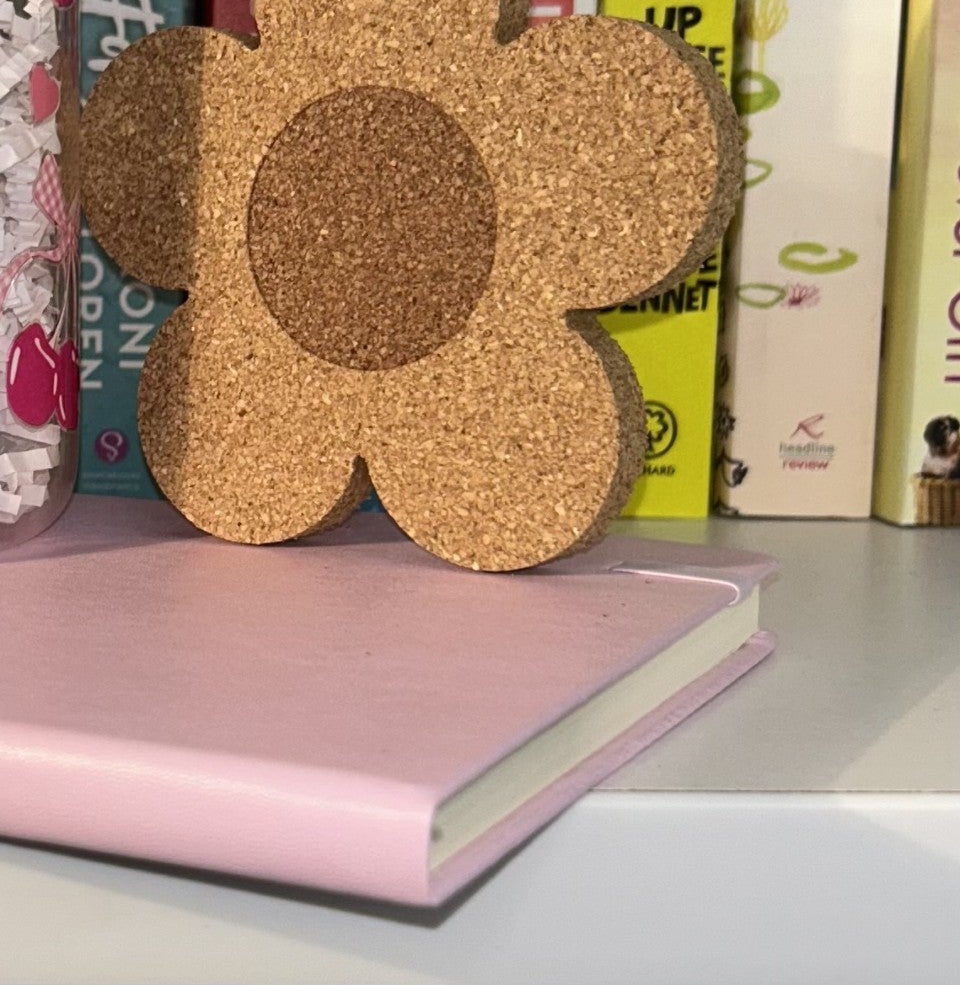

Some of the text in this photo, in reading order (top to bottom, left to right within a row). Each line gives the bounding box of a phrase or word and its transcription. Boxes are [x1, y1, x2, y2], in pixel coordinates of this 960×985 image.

[80, 253, 105, 389] OREN
[118, 282, 155, 369] ONI
[779, 442, 835, 455] headline
[782, 460, 829, 471] review
